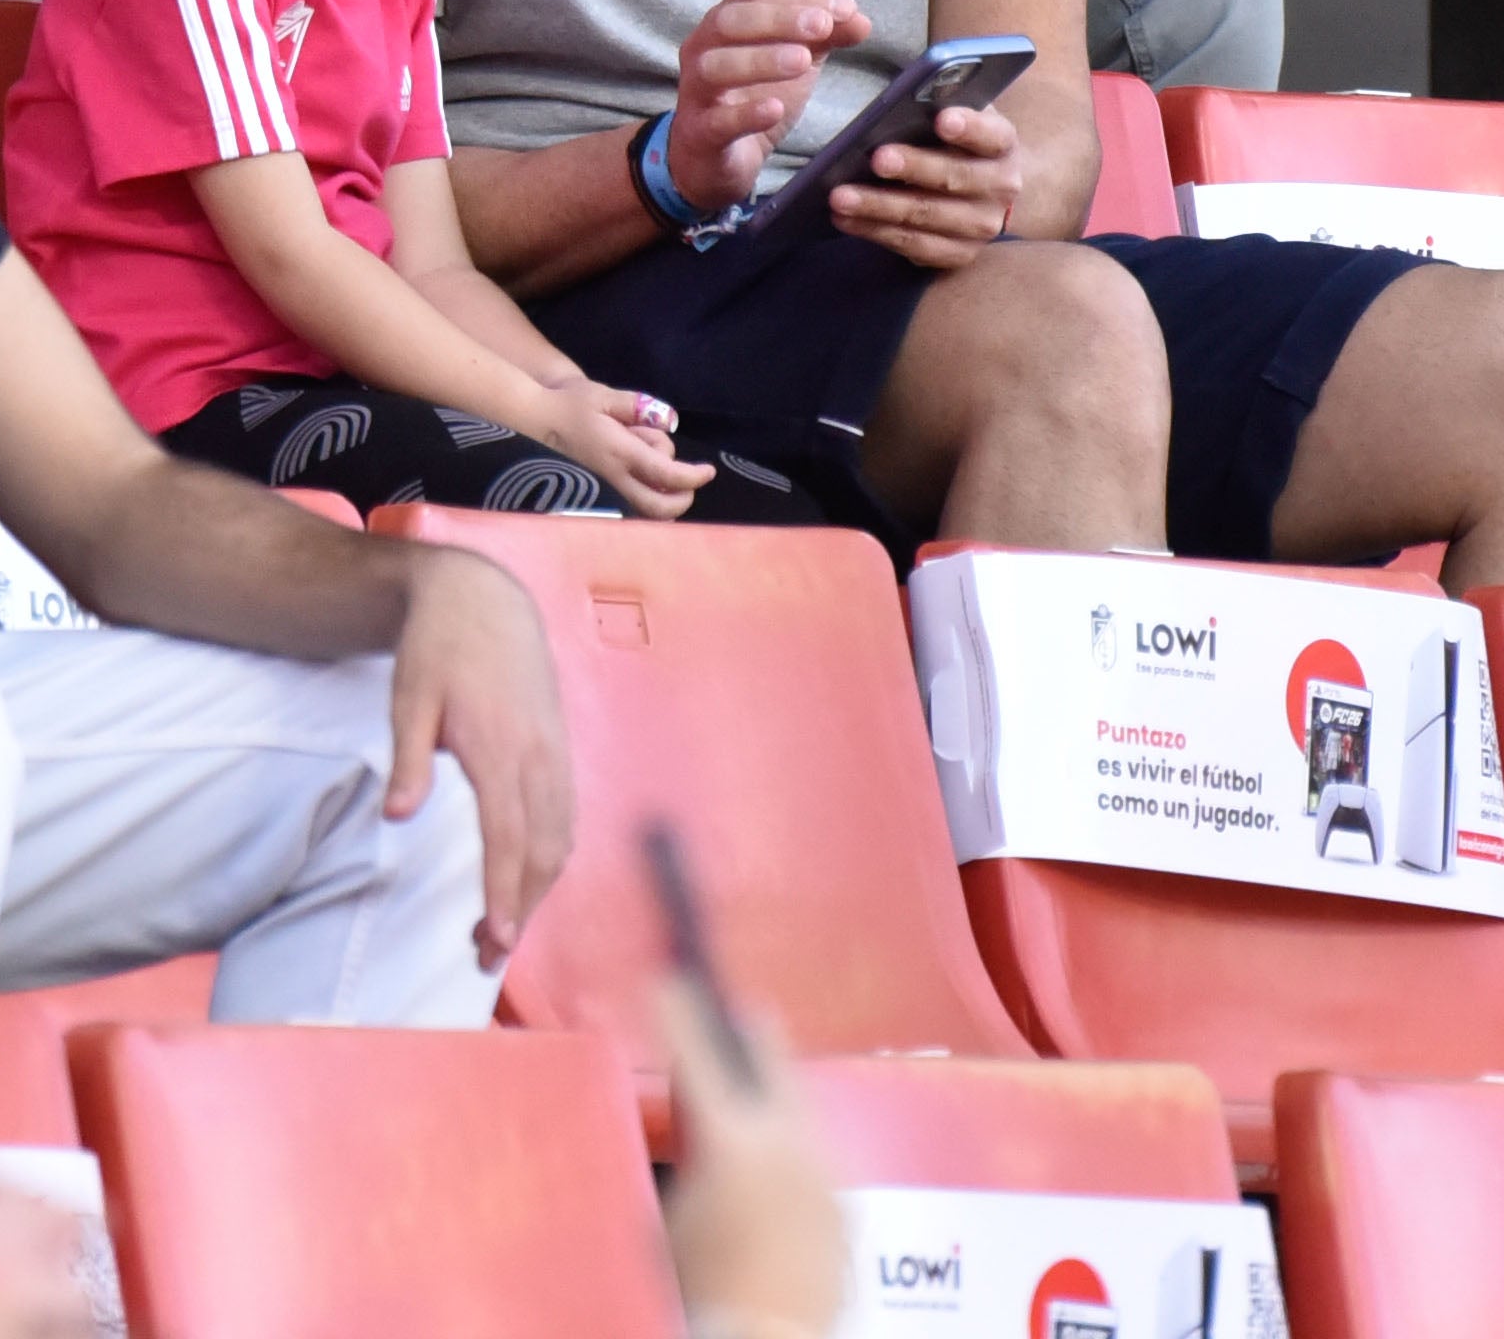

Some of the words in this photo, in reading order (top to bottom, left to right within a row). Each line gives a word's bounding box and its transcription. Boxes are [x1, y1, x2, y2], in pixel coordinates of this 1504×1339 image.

[1154, 664, 1182, 678] punto
[1183, 667, 1195, 679] de
[1097, 719, 1187, 750] Puntazo
[1097, 757, 1123, 778] es
[1127, 756, 1176, 784] vivir
[1179, 764, 1198, 787] el
[1202, 764, 1263, 796] fútbol
[1097, 792, 1159, 817] como
[1163, 798, 1190, 821] un
[1193, 797, 1280, 833] jugador.
